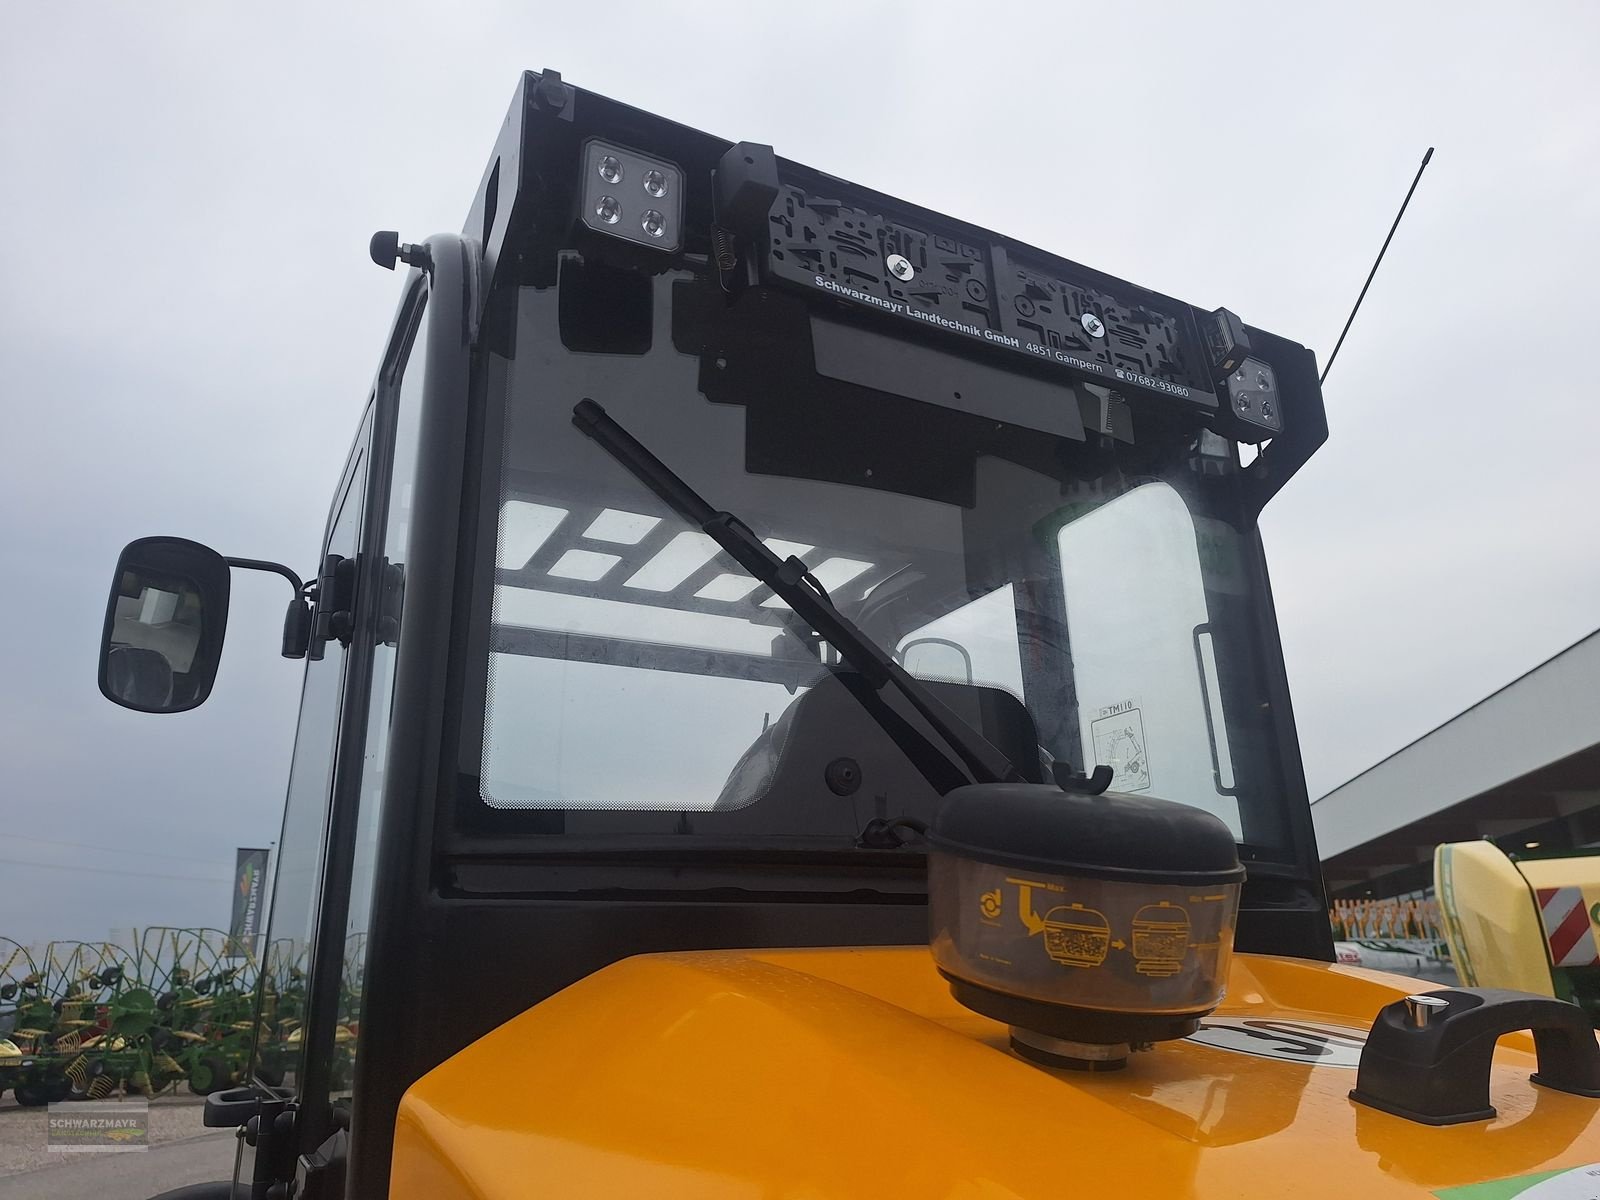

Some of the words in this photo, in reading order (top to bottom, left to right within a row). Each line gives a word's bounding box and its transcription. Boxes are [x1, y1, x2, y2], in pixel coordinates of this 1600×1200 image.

[815, 276, 903, 313] Schwarzmayr
[906, 305, 981, 337] Landtechnik
[984, 330, 1020, 349] GmbH
[1026, 342, 1051, 358] 4851
[1055, 351, 1103, 374] Gampern
[1126, 371, 1189, 398] 07682-93080
